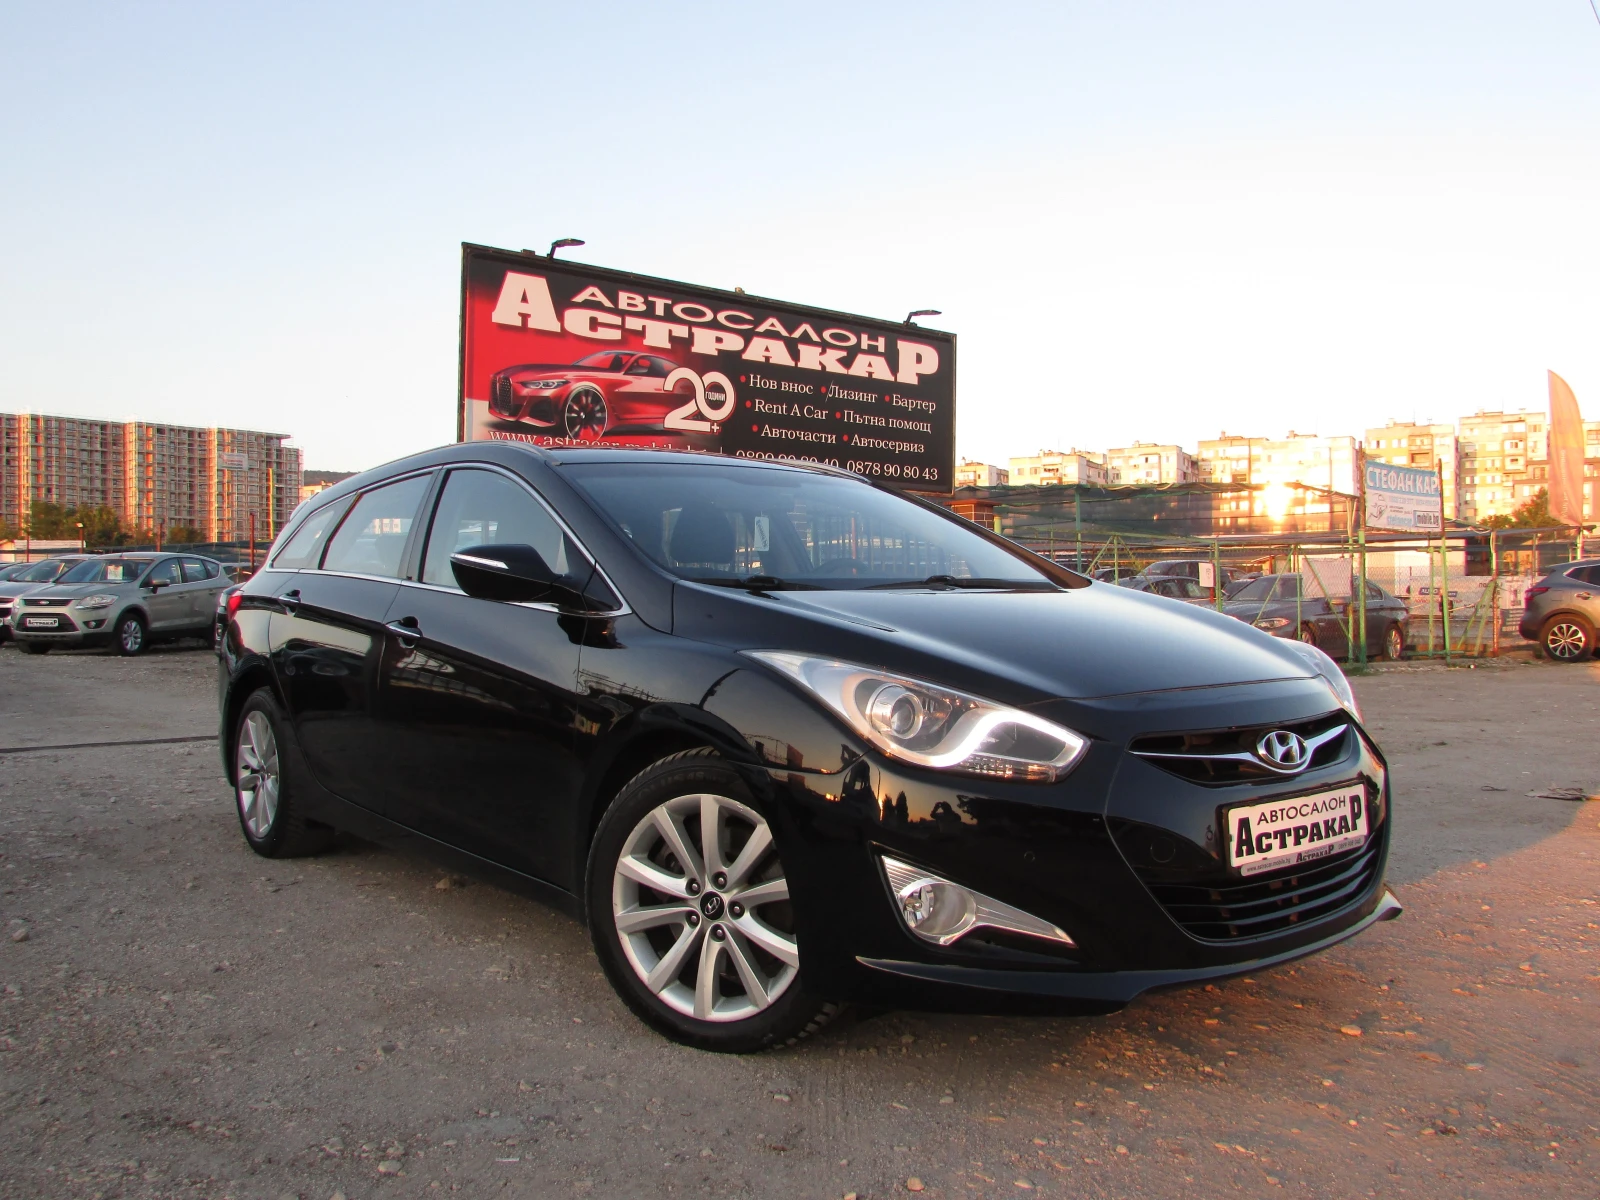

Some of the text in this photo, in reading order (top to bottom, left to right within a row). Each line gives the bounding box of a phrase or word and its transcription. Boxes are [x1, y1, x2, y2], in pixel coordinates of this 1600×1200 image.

[571, 286, 886, 353] АВТОСАЛОН
[749, 374, 936, 413] Нов внос Лизинг Бартер
[754, 399, 829, 420] Rent A Car
[760, 424, 837, 444] Авточасти
[843, 410, 932, 435] Пътна помощ
[851, 434, 925, 454] Автосервиз
[846, 460, 938, 481] 0878 90 80 43
[1366, 466, 1415, 493] СТЕФАН
[1257, 795, 1346, 826] АВТОСАЛОН
